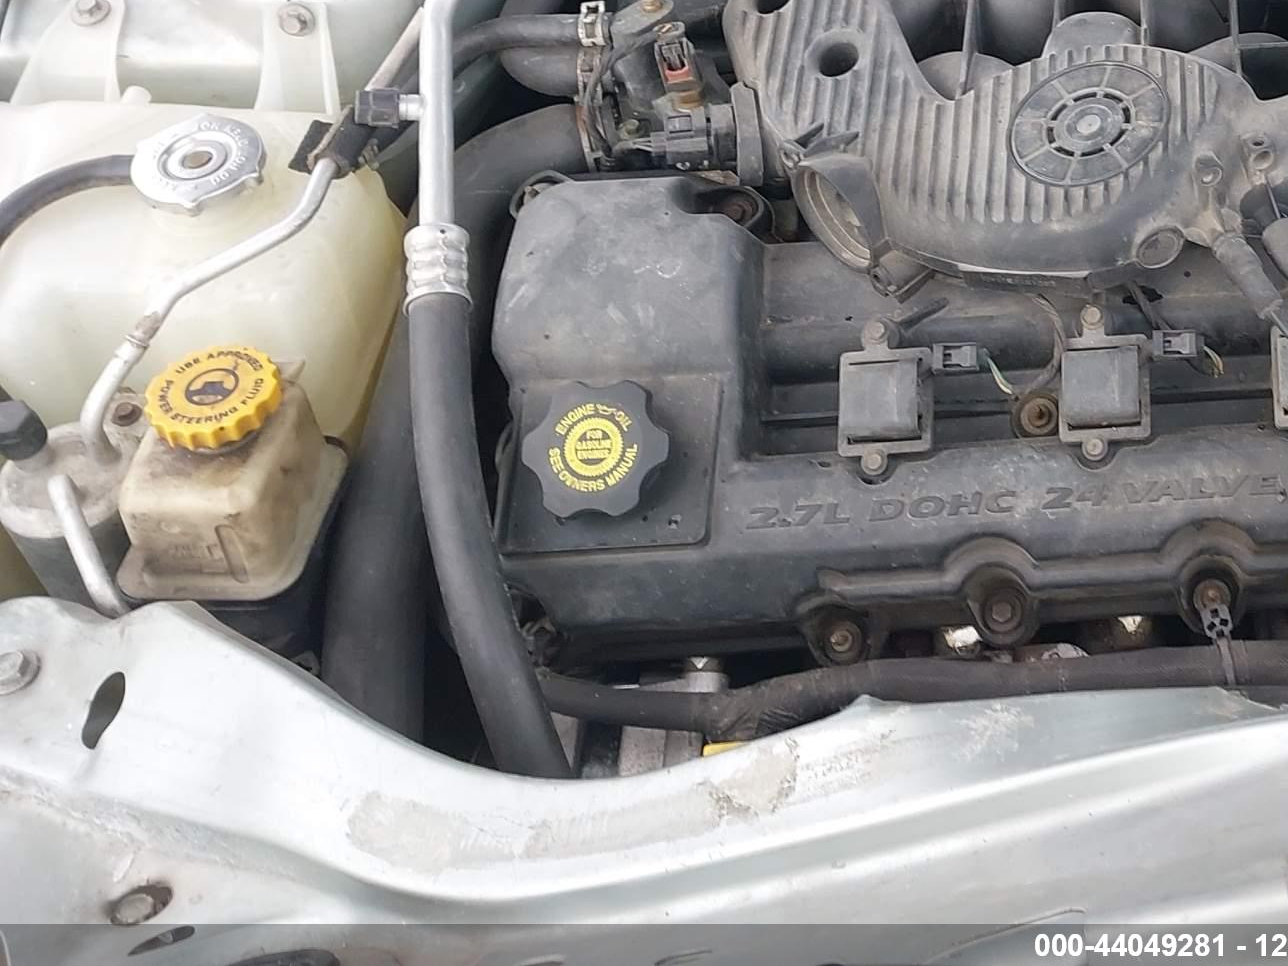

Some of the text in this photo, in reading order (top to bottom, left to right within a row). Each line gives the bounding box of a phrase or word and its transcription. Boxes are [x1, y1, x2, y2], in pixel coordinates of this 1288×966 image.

[158, 378, 264, 425] POWER STEERING FLUID
[555, 403, 632, 436] ENGINE OIL
[548, 443, 638, 492] SEE OWNERS MANUAL
[746, 475, 1286, 530] 2.7L DOHC 24 VALVE
